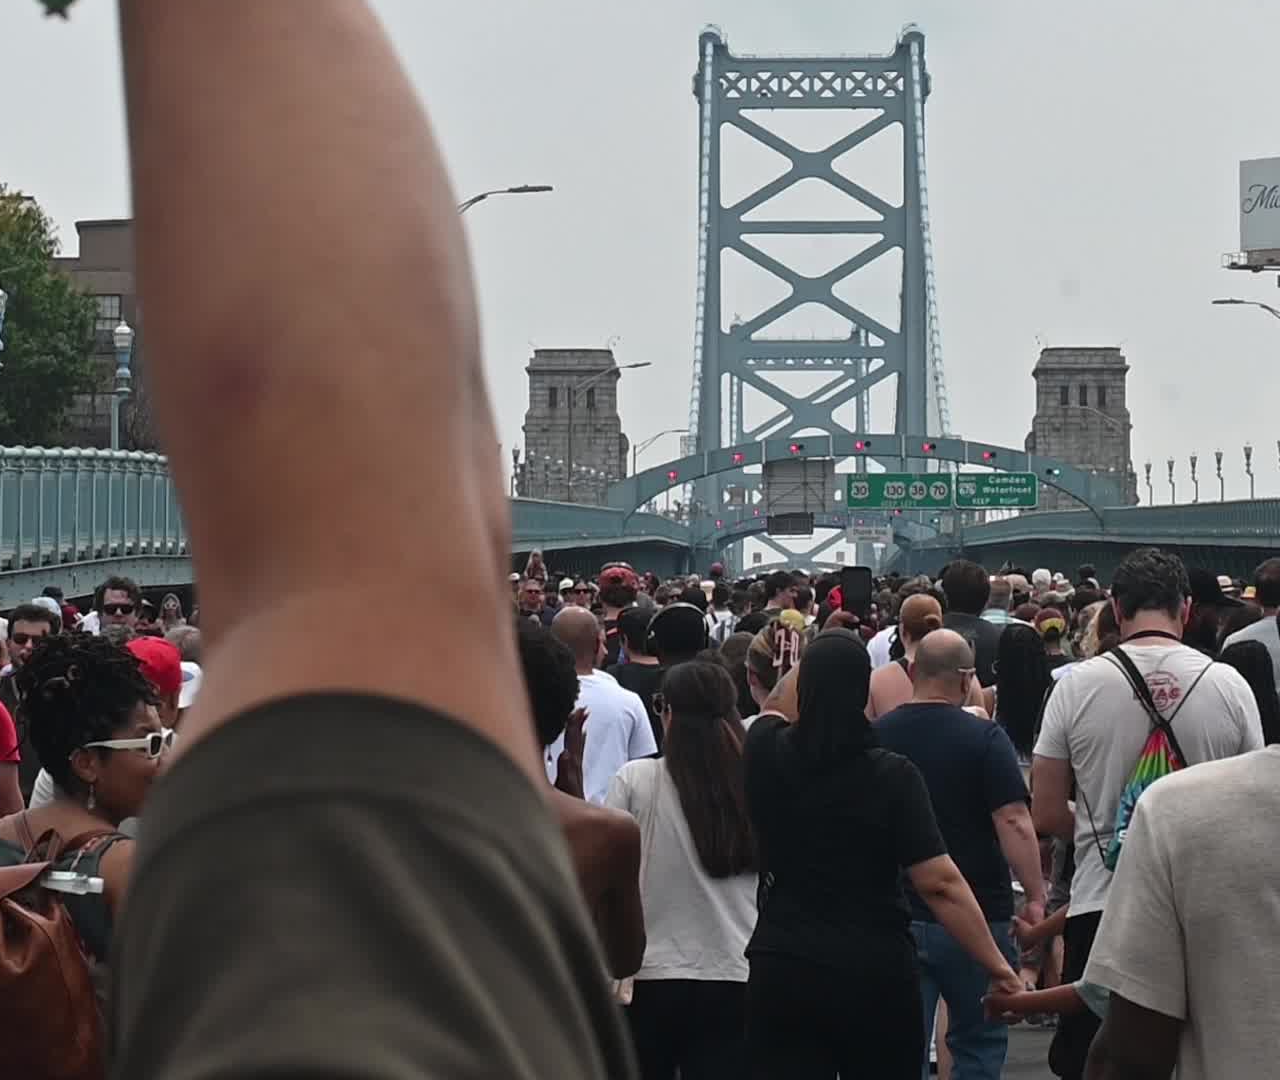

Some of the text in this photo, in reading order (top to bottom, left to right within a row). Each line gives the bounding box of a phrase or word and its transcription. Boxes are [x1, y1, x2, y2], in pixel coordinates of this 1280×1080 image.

[988, 475, 1026, 484] Camden
[853, 485, 867, 496] 30
[933, 484, 946, 495] 70
[982, 486, 1032, 494] Waterfront
